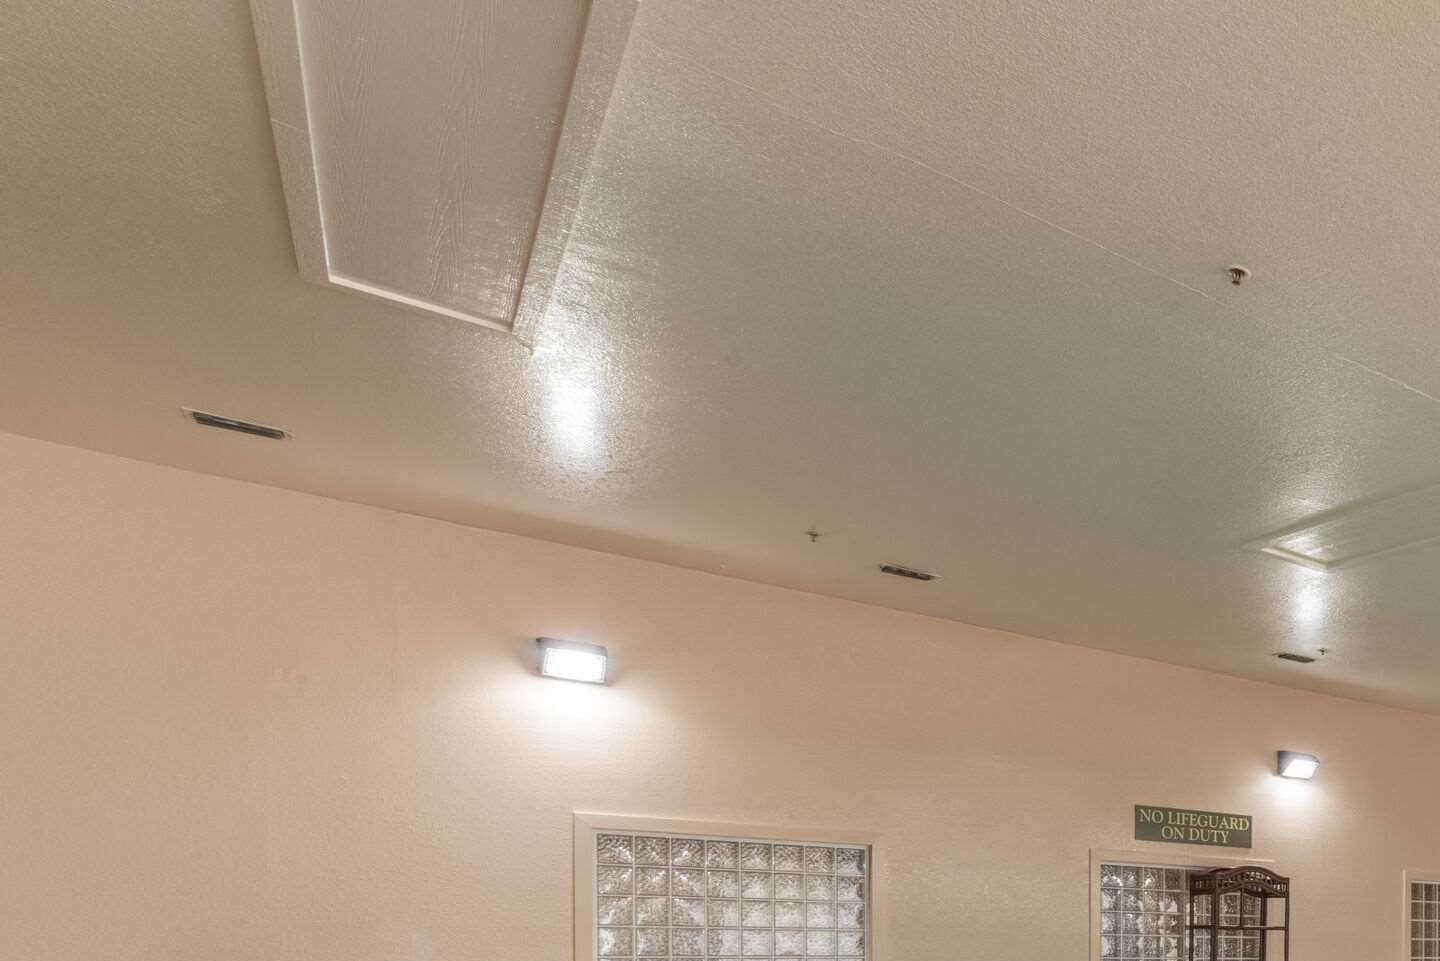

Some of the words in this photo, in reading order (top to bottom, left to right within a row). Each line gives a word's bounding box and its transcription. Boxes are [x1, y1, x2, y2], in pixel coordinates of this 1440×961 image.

[1140, 809, 1164, 823] NO
[1168, 811, 1250, 831] LIFEGUARD
[1161, 826, 1185, 840] ON
[1189, 828, 1230, 843] DUTY
